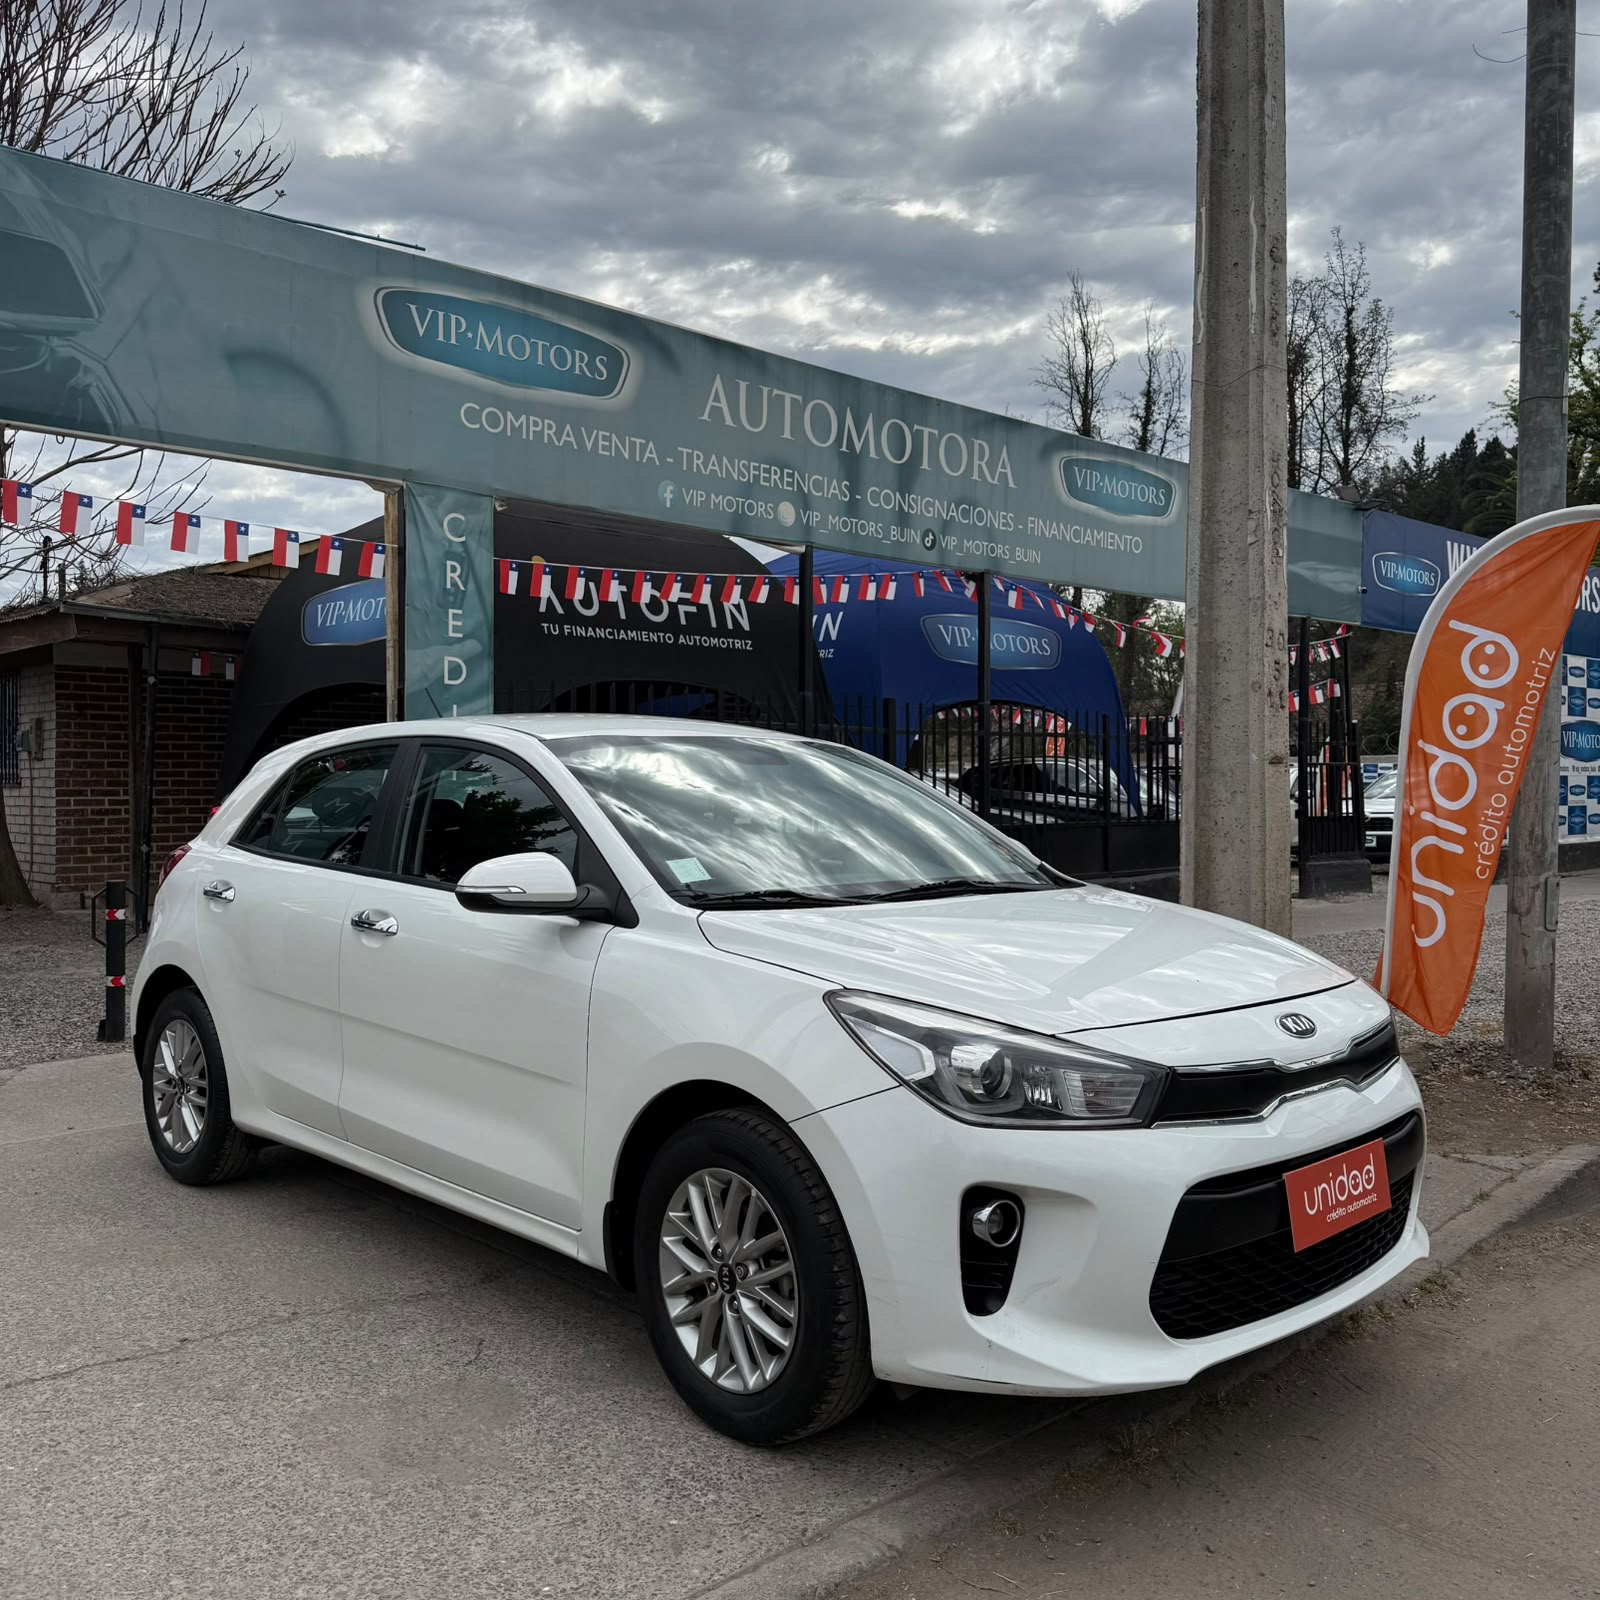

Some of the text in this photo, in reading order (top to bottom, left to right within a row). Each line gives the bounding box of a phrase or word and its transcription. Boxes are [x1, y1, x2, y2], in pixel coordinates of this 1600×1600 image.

[698, 373, 1017, 489] AUTOMOTORA
[678, 447, 850, 502] TRANSFERENCIAS
[867, 487, 1015, 532] CONSIGNACIONES
[1027, 517, 1143, 554] FINANCIAMIENTO
[681, 487, 706, 507] VIP
[711, 492, 774, 520] MOTORS
[800, 508, 921, 544] VIP_MOTORS_BUIN
[540, 622, 753, 651] TU FINANCIAMIENTO AUTOMOTRIZ
[976, 629, 1051, 657] OTORS
[1408, 619, 1519, 948] unidad
[1474, 647, 1556, 880] crédito automotriz
[1303, 1152, 1375, 1216] unidad
